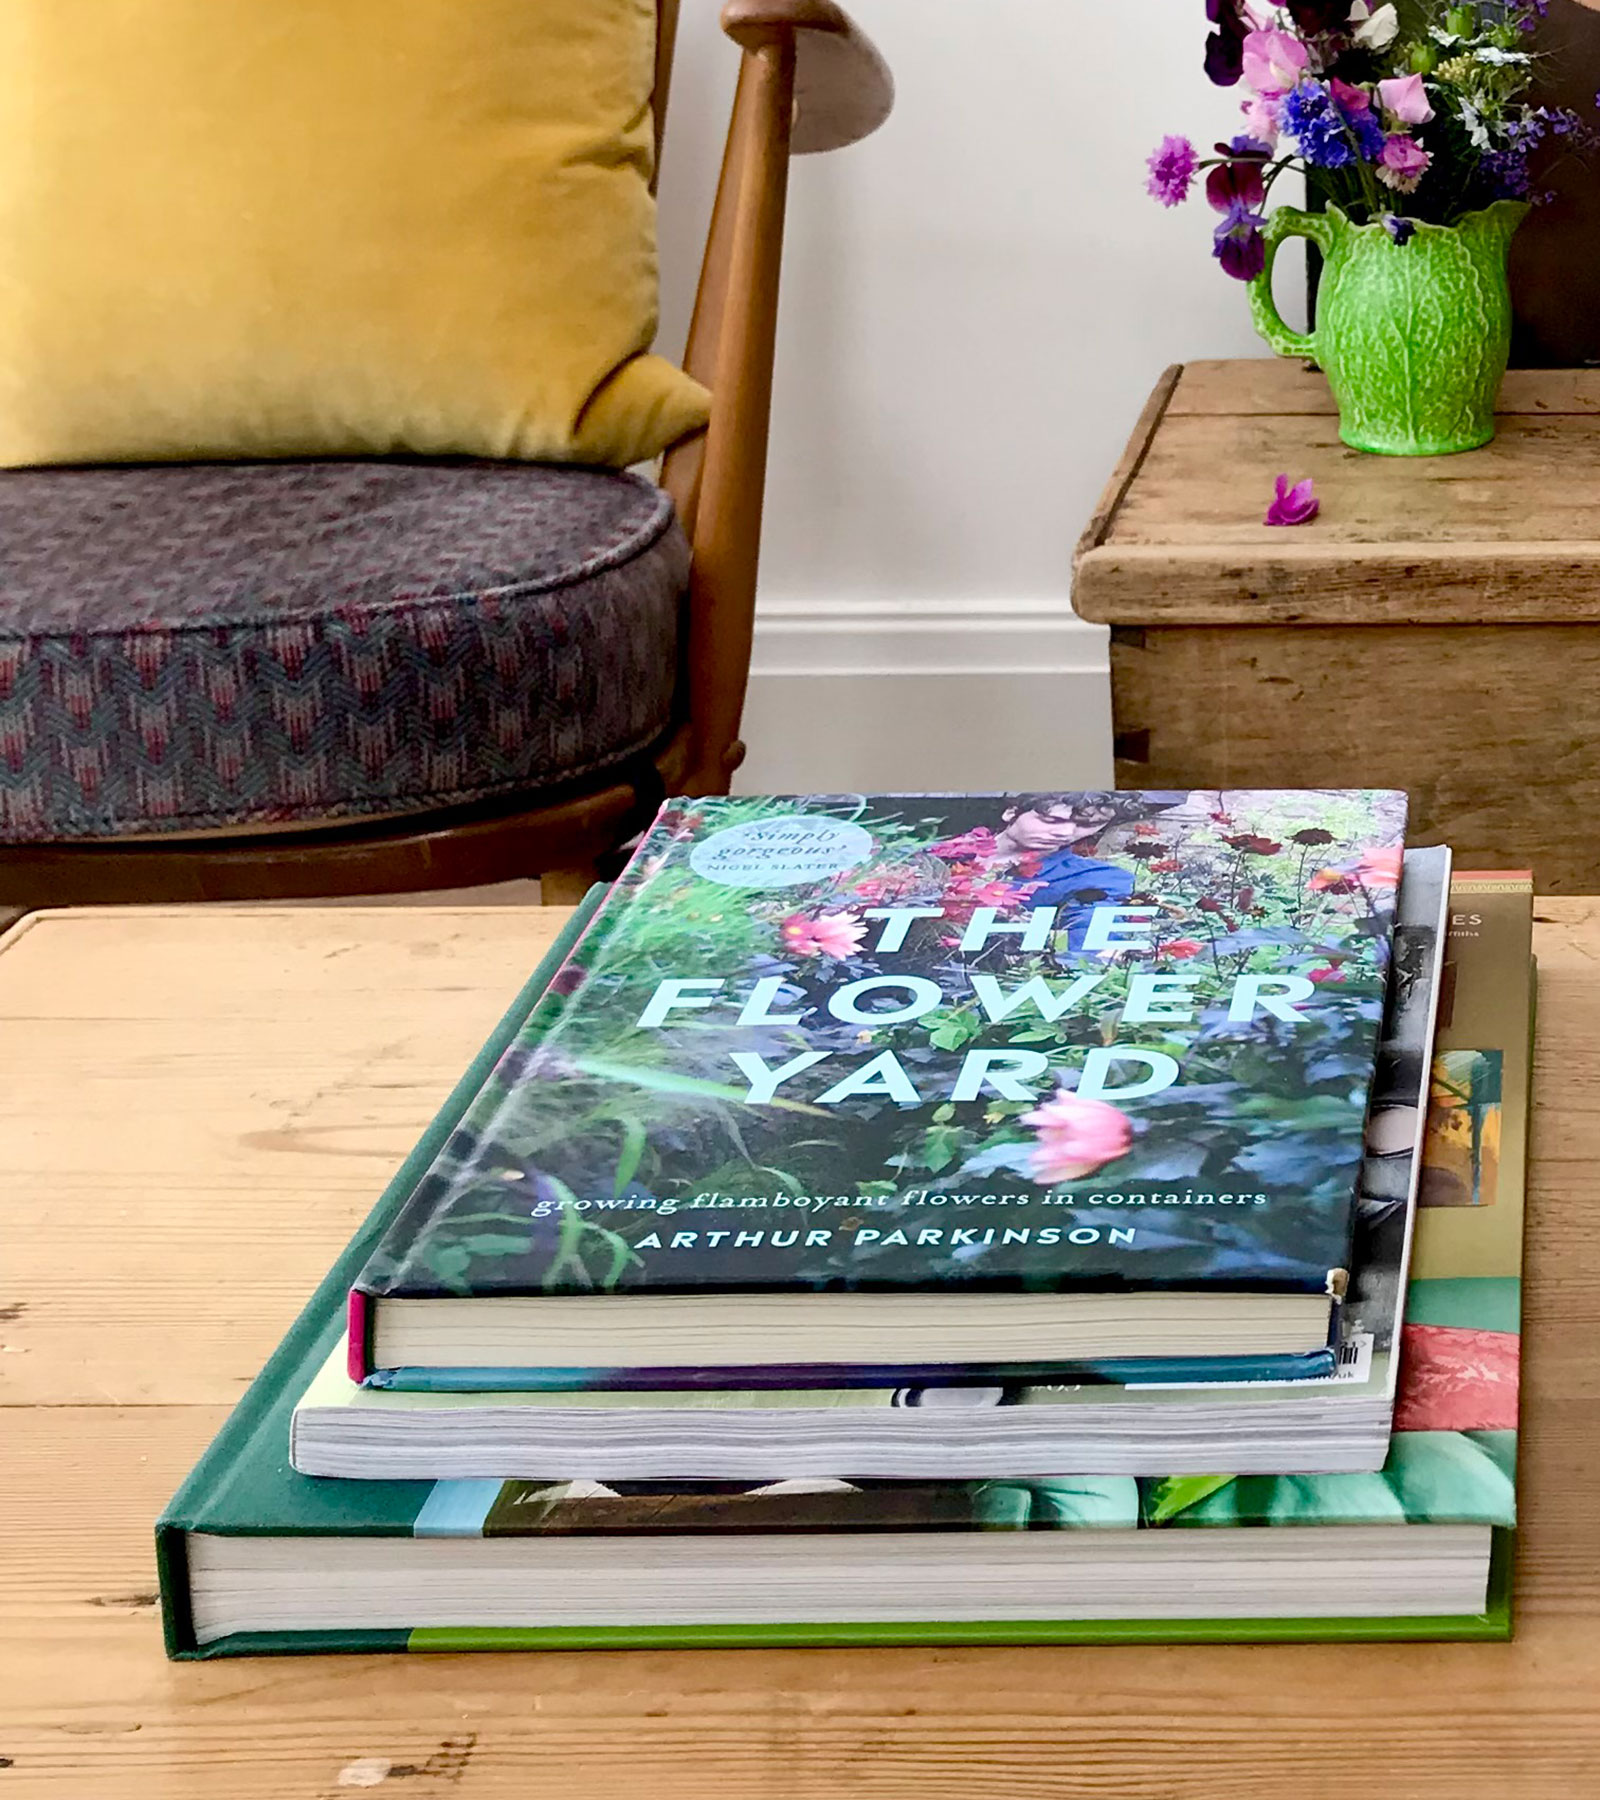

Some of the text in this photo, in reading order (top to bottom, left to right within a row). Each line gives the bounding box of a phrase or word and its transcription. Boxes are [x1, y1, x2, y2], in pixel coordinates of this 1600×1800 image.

[864, 906, 1158, 952] THE
[637, 974, 1315, 1027] FLOWER
[728, 1048, 1180, 1105] YARD
[530, 1189, 1267, 1217] growing flamboyant flowers in containers
[634, 1228, 1136, 1250] ARTHUR PARKINSON
